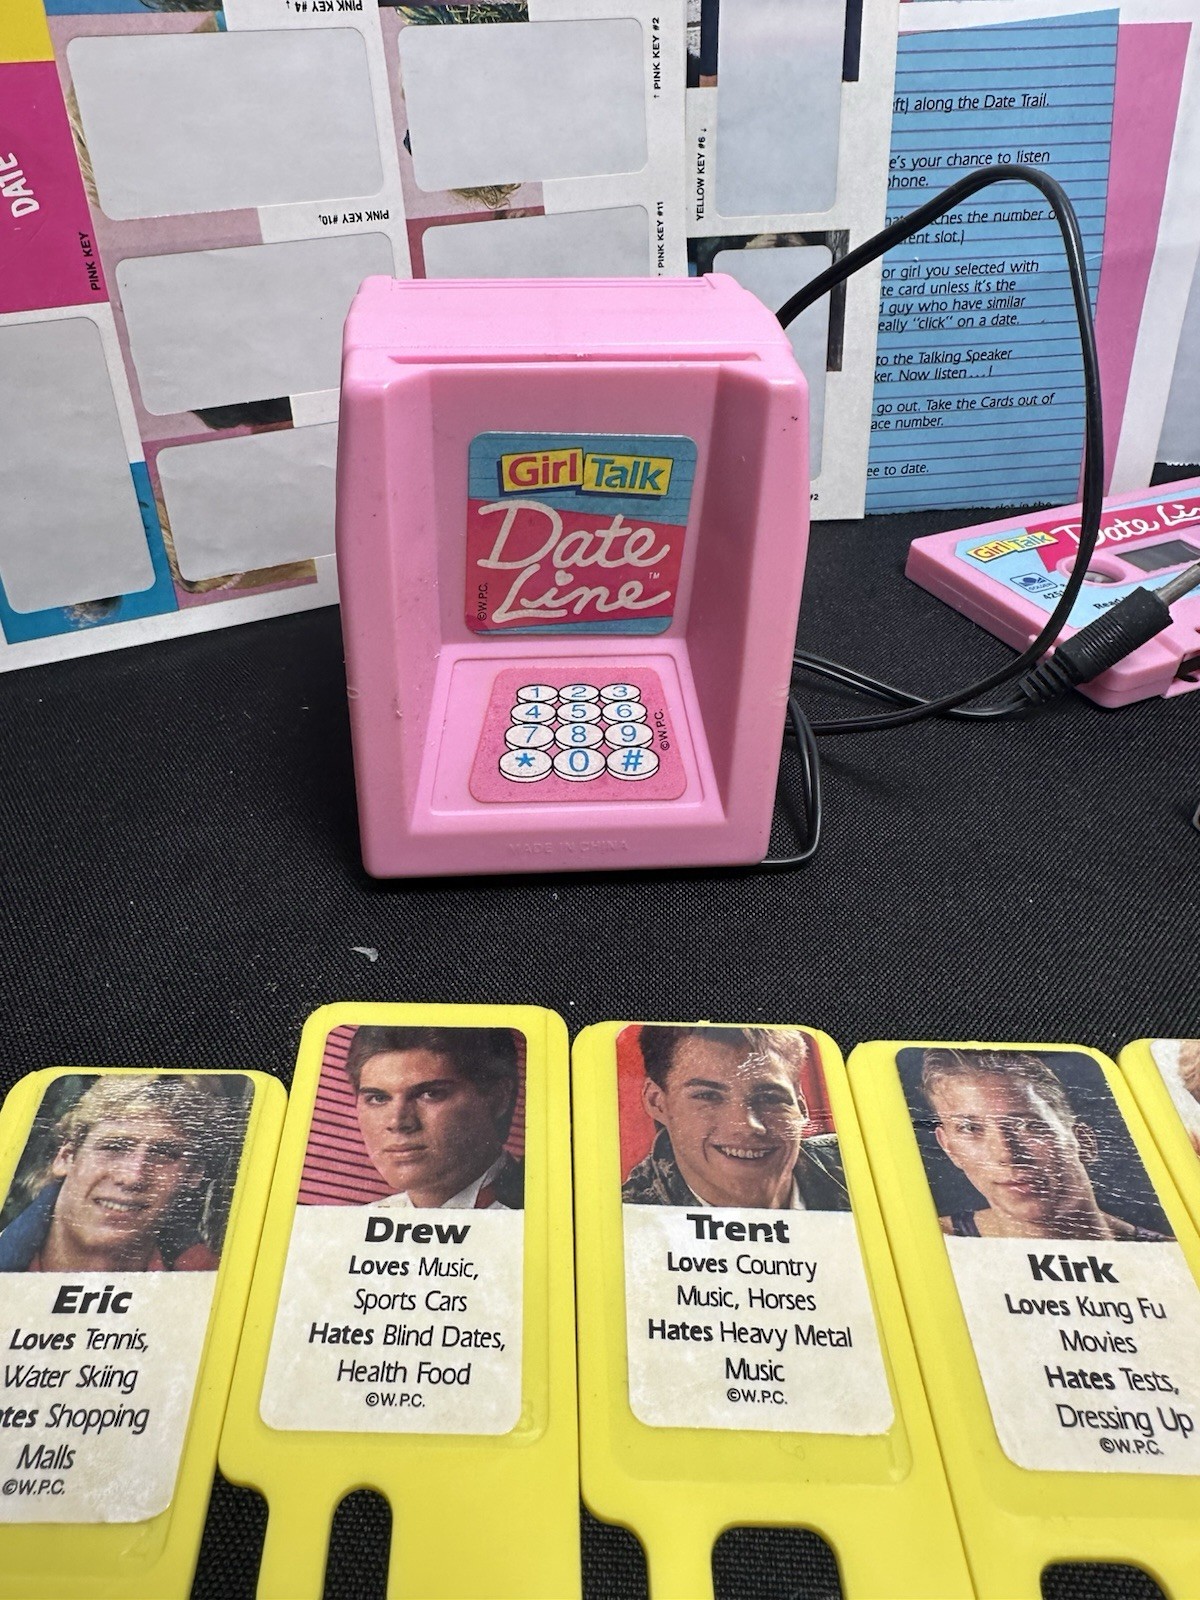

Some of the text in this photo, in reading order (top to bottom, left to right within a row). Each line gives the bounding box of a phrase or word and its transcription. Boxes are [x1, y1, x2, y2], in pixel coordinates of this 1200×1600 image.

[295, 0, 363, 12] PINK KEY #4
[652, 17, 660, 30] #2
[653, 62, 661, 89] PINK
[914, 97, 953, 113] along
[958, 96, 979, 109] the
[984, 94, 1016, 108] Date
[1021, 93, 1050, 107] Trail.
[888, 150, 1050, 171] e's your chance to listen
[0, 152, 40, 218] DATE
[696, 136, 706, 221] YELLOW KEY #6
[321, 210, 389, 225] PINK KEY #10
[968, 211, 988, 223] the
[993, 209, 1044, 222] number
[1048, 210, 1059, 220] o
[935, 230, 964, 245] slot.)
[78, 232, 101, 291] PINK KEY
[882, 260, 1039, 280] or girl you selected with
[881, 279, 1016, 296] te card unless it's the
[889, 303, 914, 316] guy
[918, 300, 947, 312] who
[952, 299, 982, 310] have
[987, 296, 1026, 309] similar
[878, 319, 908, 333] eally
[957, 317, 974, 328] on
[979, 317, 986, 326] a
[991, 314, 1020, 326] date.
[876, 349, 1012, 366] to the Talking Speaker
[874, 370, 893, 382] ker.
[899, 369, 930, 381] Now
[877, 392, 1056, 416] go out. Take the Cards out of
[895, 416, 943, 429] number.
[508, 452, 665, 491] Girl Talk
[866, 463, 929, 476] ee to date.
[477, 500, 670, 569] Date
[973, 532, 1047, 558] Girl Talk
[477, 582, 488, 621] ©W.P.C.
[492, 563, 671, 623] Line
[531, 686, 628, 698] 1 2 3
[525, 704, 633, 718] 4 5 6
[522, 725, 637, 743] 7 8 9
[654, 708, 670, 751] ©W.P.C.
[569, 750, 590, 772] 0
[621, 750, 644, 772] #
[508, 842, 553, 854] MADE
[580, 840, 629, 853] CHINA
[365, 1216, 471, 1244] Drew
[687, 1213, 790, 1244] Trent
[349, 1255, 479, 1281] Loves Music,
[667, 1252, 817, 1283] Loves Country
[1027, 1254, 1120, 1284] Kirk
[52, 1285, 133, 1314] Eric
[354, 1288, 467, 1315] Sports Cars
[677, 1285, 817, 1311] Music, Horses
[1004, 1293, 1167, 1324] Loves Kung Fu
[9, 1328, 149, 1352] Loves Tennis,
[308, 1322, 506, 1351] Hates Blind Dates,
[648, 1319, 853, 1351] Hates Heavy Metal
[1059, 1329, 1138, 1354] Movies
[4, 1364, 139, 1394] Water Skiing
[337, 1360, 472, 1385] Health Food
[725, 1357, 785, 1382] Music
[1044, 1365, 1180, 1395] Hates Tests,
[365, 1393, 425, 1408] ©W.P.C.
[726, 1388, 788, 1405] ©W.P.C.
[0, 1403, 150, 1435] tes Shopping
[1056, 1403, 1194, 1439] Dressing Up
[16, 1443, 76, 1470] Malls
[1099, 1437, 1164, 1456] ©W.P.C.
[2, 1479, 66, 1495] ©W.P.C.
